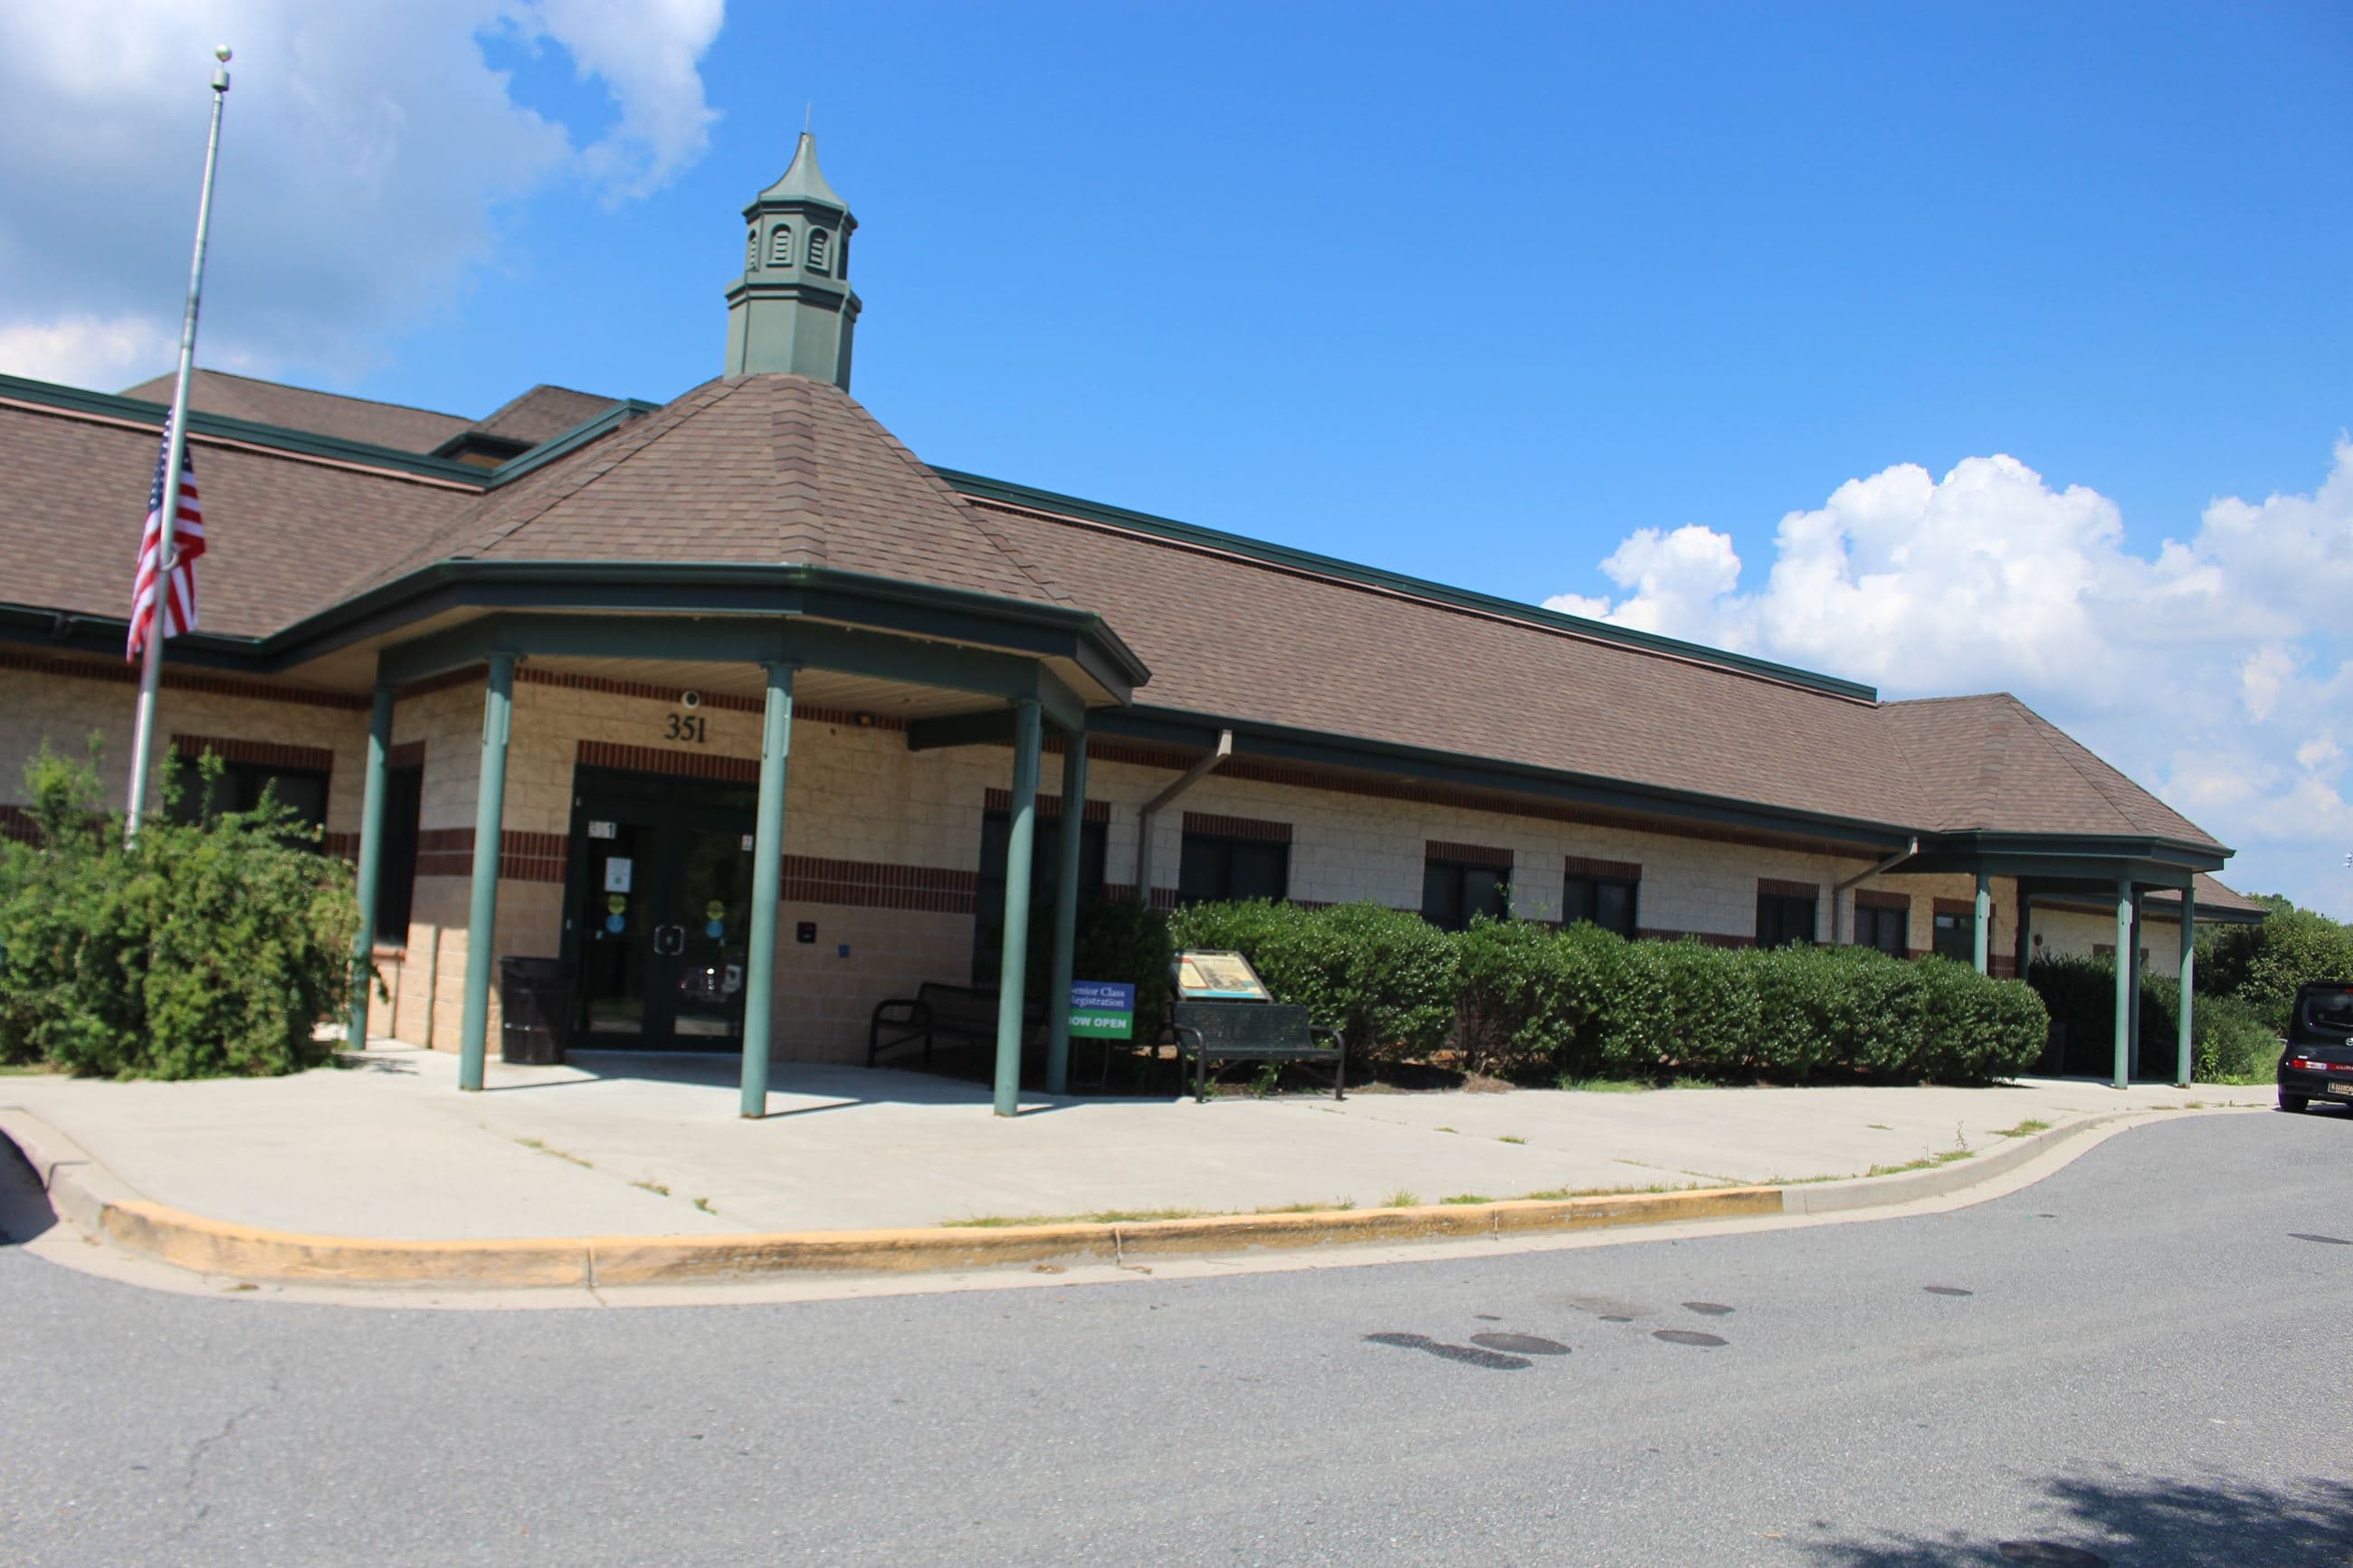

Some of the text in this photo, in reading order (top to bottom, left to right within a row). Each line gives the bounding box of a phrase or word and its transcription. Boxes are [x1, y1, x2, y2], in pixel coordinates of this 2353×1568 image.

[663, 713, 706, 744] 351
[1072, 986, 1125, 998] enior Class
[1093, 1017, 1127, 1029] OPEN
